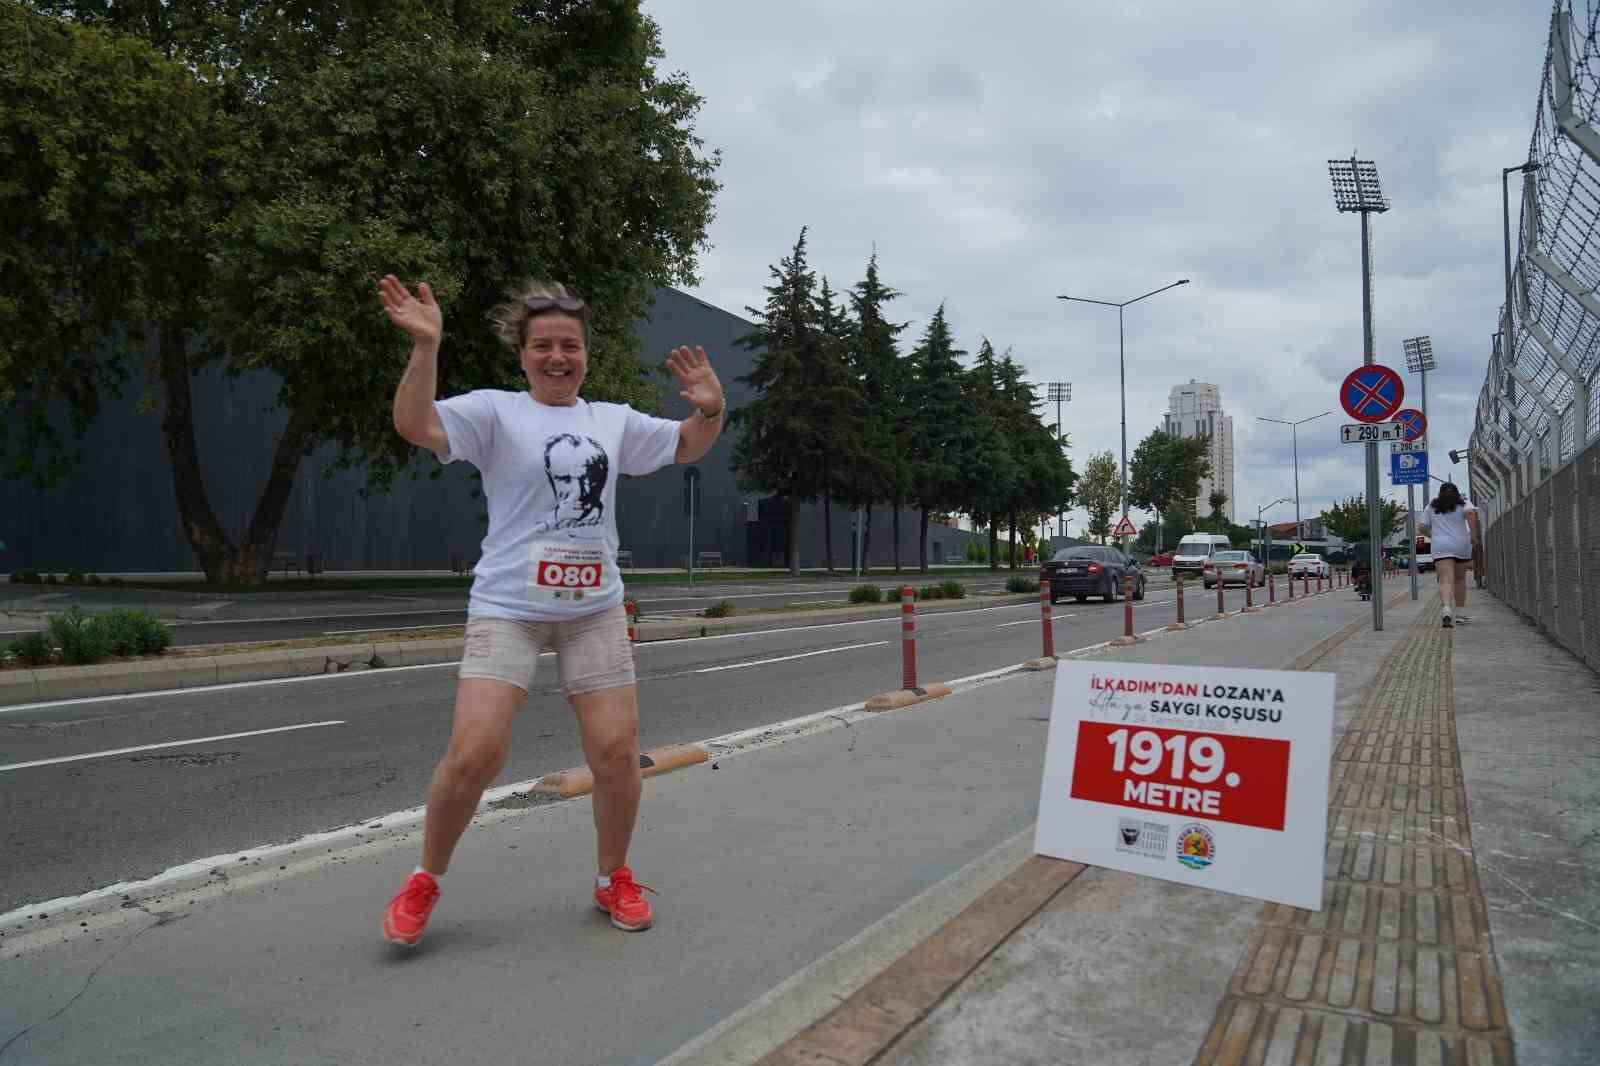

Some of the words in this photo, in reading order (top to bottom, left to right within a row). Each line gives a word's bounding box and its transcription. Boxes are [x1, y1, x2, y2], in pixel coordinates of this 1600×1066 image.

[1359, 426, 1378, 440] 290
[1382, 430, 1391, 439] m
[544, 564, 598, 586] 080
[1091, 674, 1198, 697] İLKADIM'DAN
[1202, 684, 1285, 703] LOZAN'A
[1150, 700, 1200, 716] SAYGI
[1205, 704, 1283, 724] KOŞUSU
[1107, 729, 1241, 788] 1919.
[1123, 779, 1221, 815] METRE
